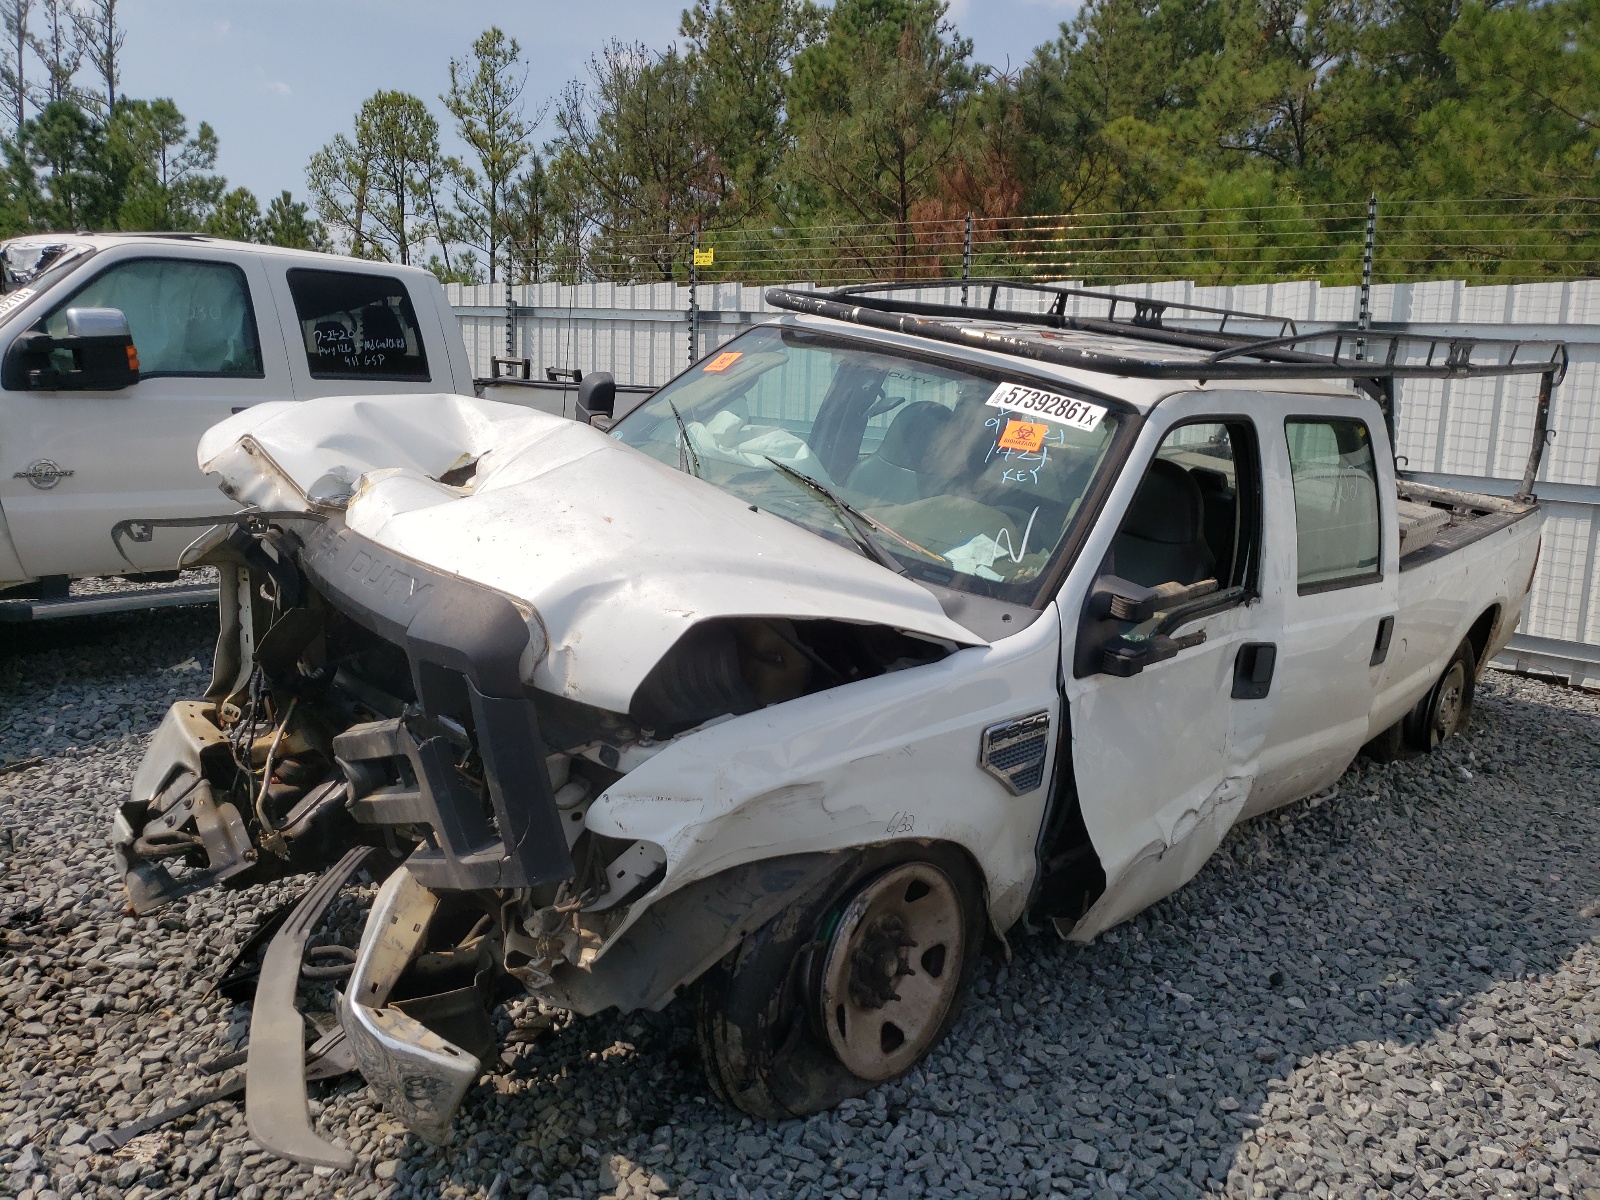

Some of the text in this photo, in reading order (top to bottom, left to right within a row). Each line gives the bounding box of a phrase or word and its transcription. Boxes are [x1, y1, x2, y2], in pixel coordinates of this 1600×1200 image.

[888, 371, 930, 385] DUTY
[1002, 465, 1041, 484] KEY
[345, 550, 434, 607] DUTY
[885, 811, 915, 838] 6/32
